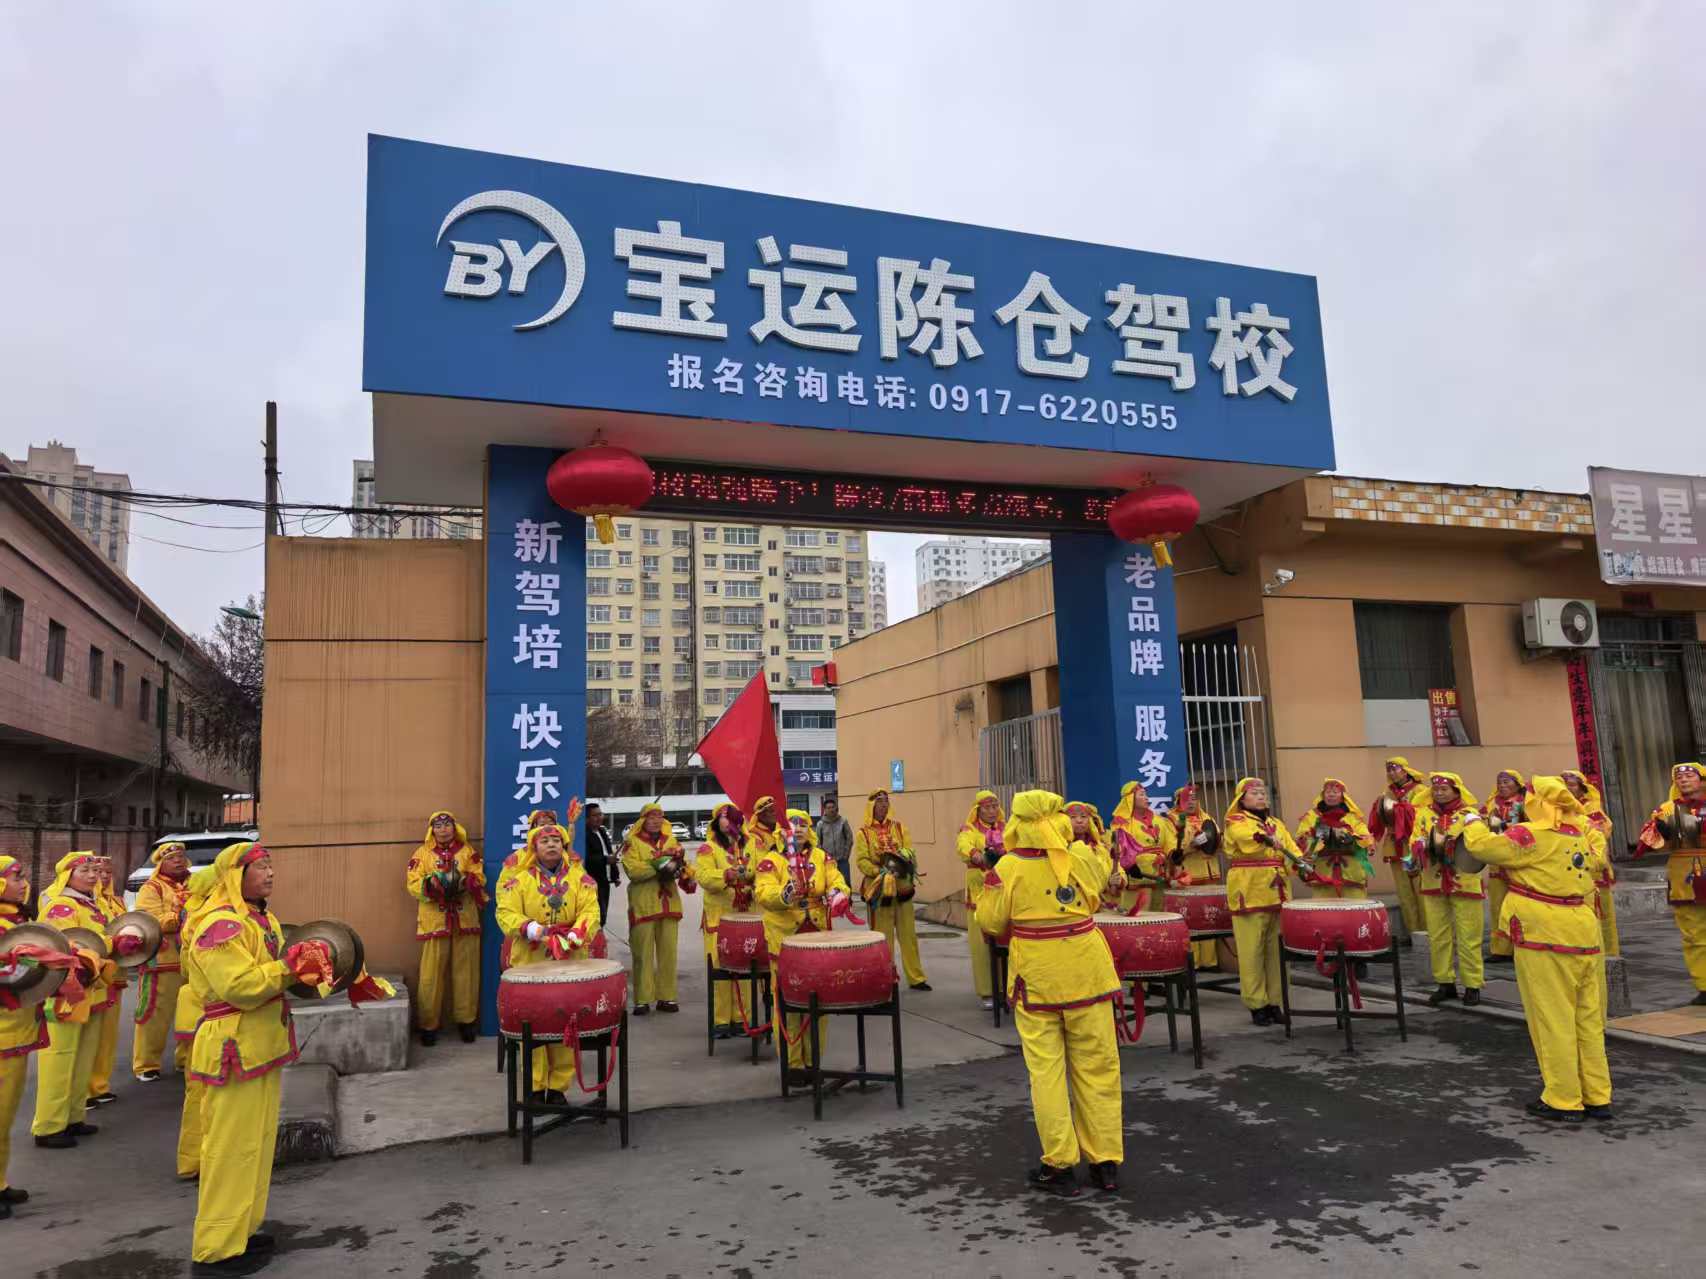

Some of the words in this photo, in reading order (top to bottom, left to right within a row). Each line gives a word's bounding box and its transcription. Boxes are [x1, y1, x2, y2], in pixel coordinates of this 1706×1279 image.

[443, 238, 558, 298] BY
[612, 219, 1299, 403] 宝运陈仓驾校
[1610, 483, 1706, 545] 星星
[811, 771, 838, 783] 宝运
